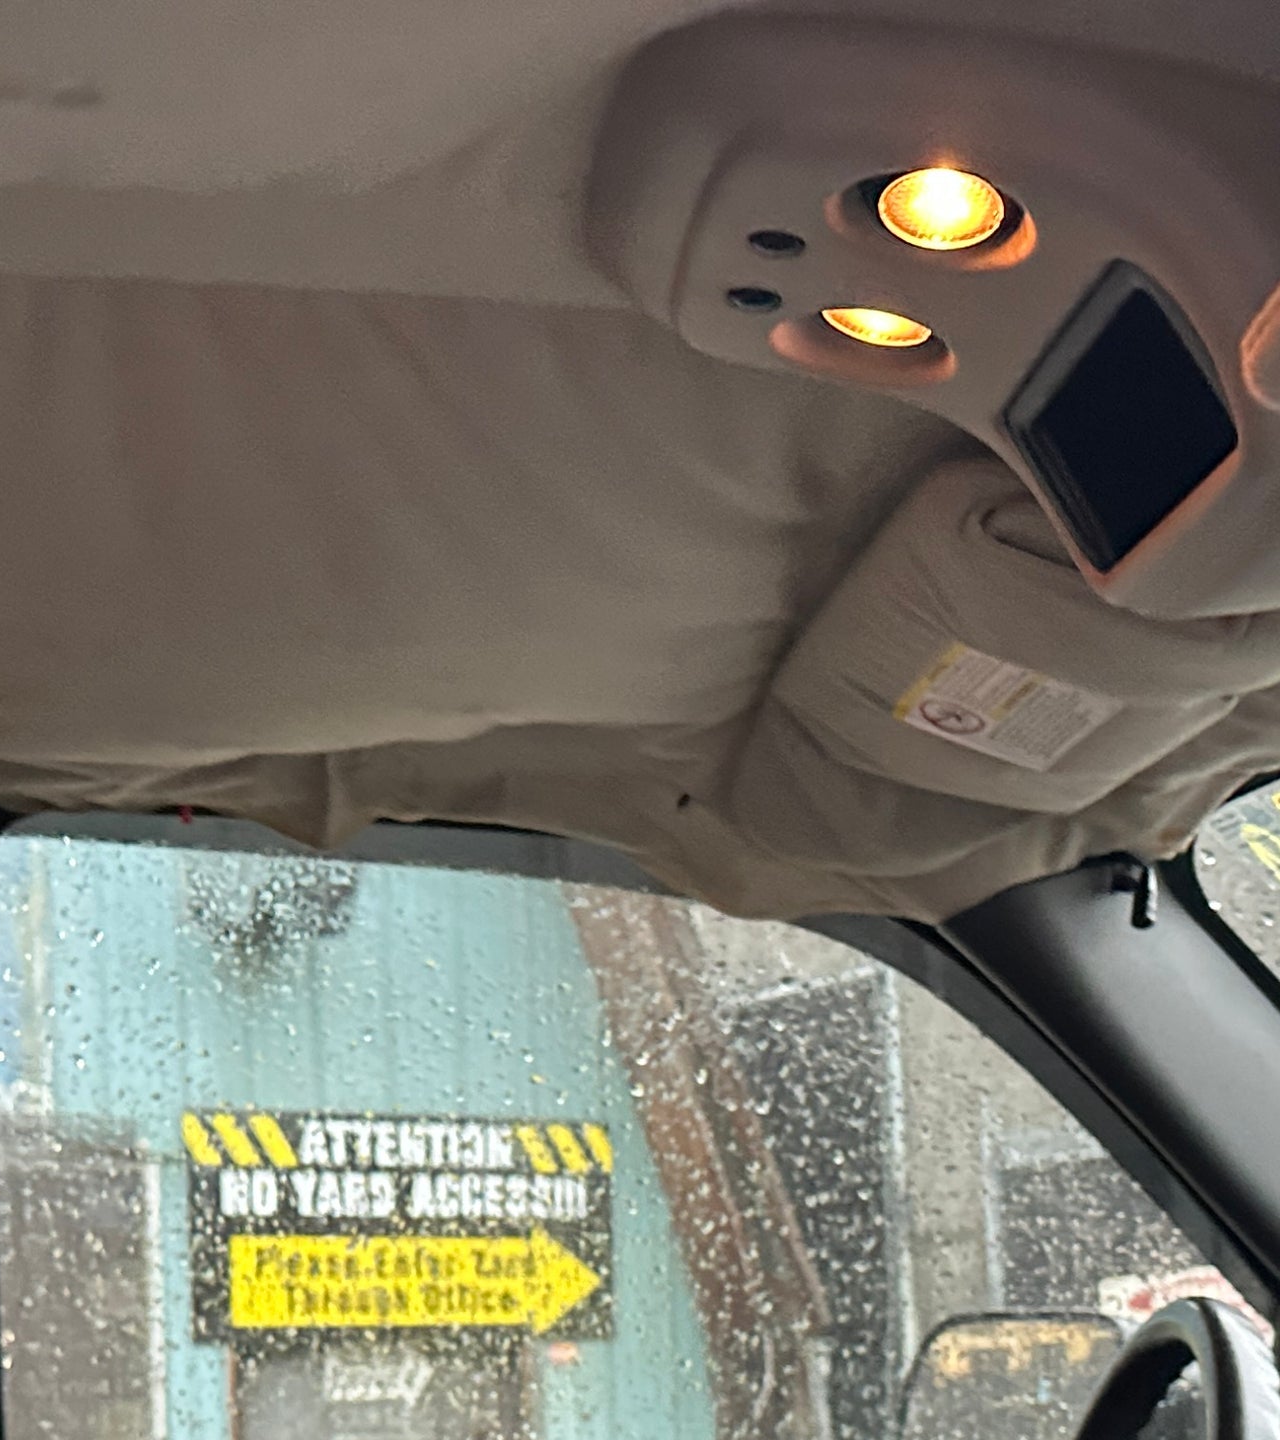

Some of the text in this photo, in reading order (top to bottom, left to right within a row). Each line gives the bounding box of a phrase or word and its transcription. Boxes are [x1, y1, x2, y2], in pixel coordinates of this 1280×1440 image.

[299, 1117, 514, 1168] ATTENTION
[220, 1168, 277, 1217] NO
[290, 1169, 396, 1219] YARD
